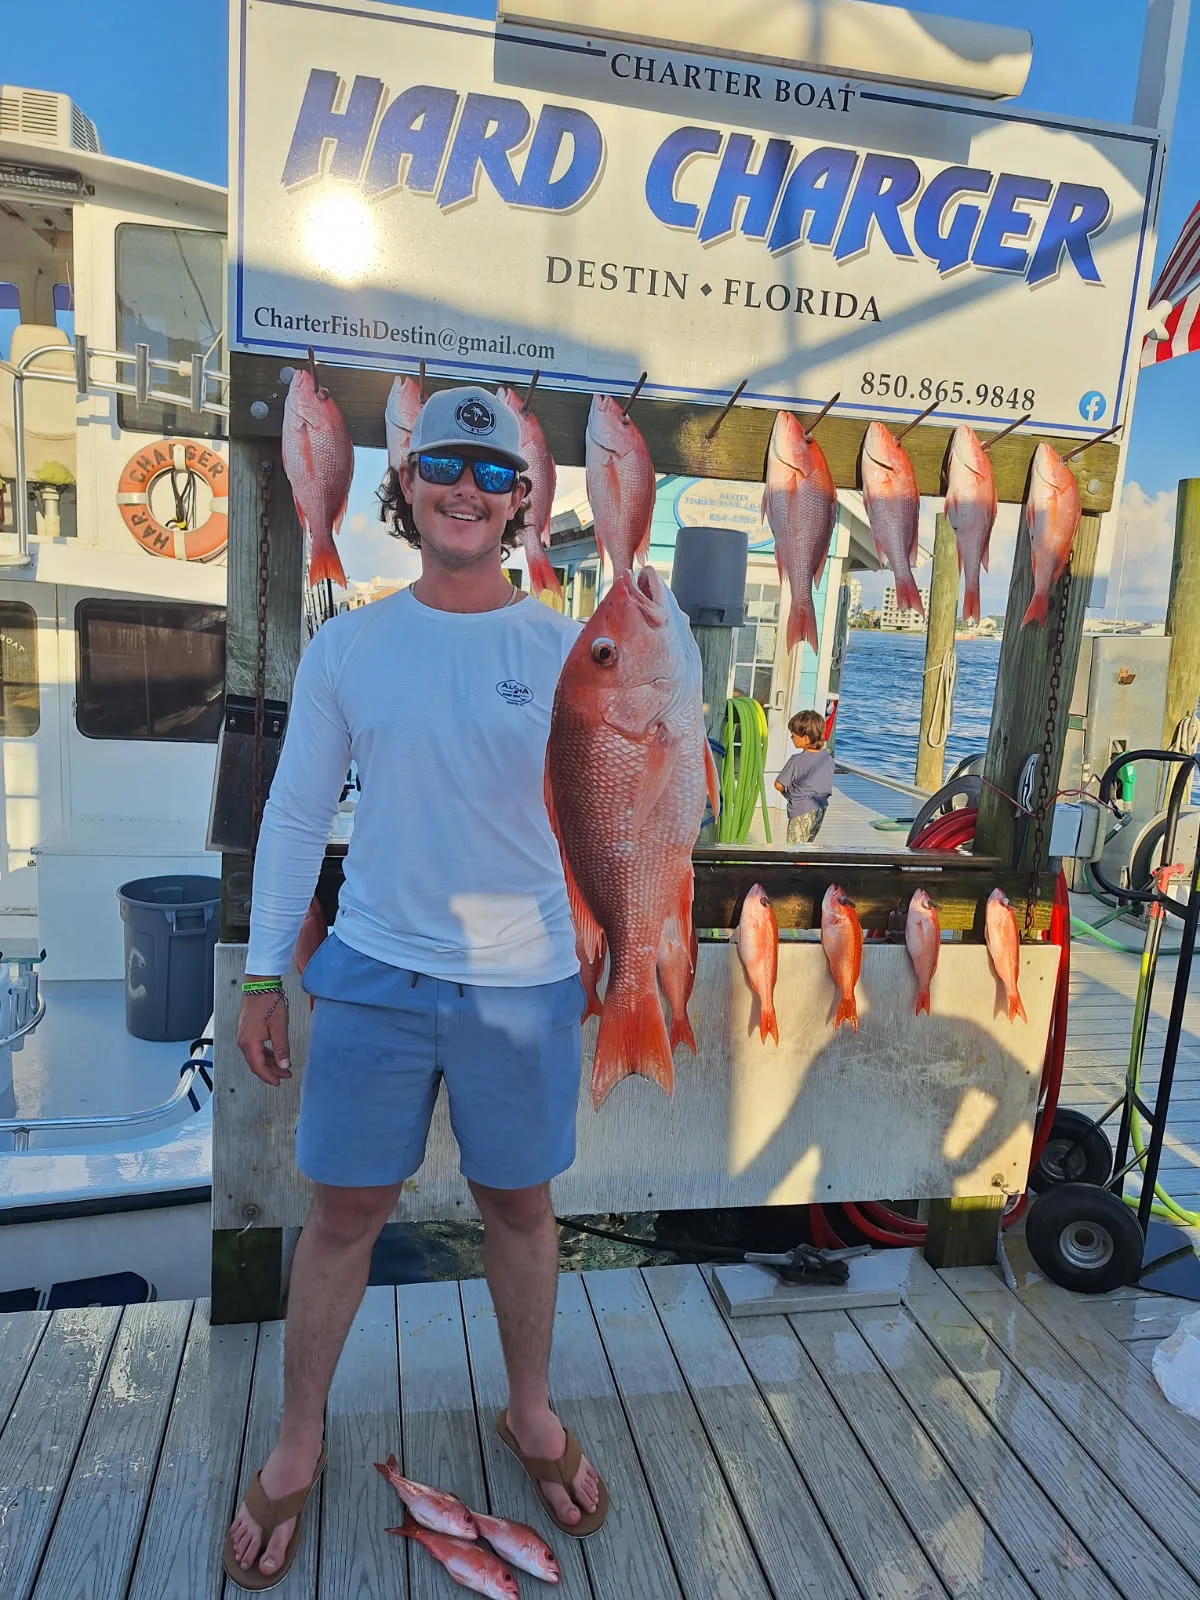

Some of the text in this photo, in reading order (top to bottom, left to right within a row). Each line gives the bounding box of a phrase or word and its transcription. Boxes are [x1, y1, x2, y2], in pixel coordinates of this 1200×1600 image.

[610, 52, 856, 113] CHARTER BOAT
[280, 68, 1112, 289] HARD CHARGER
[546, 256, 883, 323] DESTIN FLORIDA
[254, 306, 556, 360] CharterFishDestin@gmail.com
[860, 372, 1037, 412] 850.865.9848
[124, 503, 169, 550] HAR
